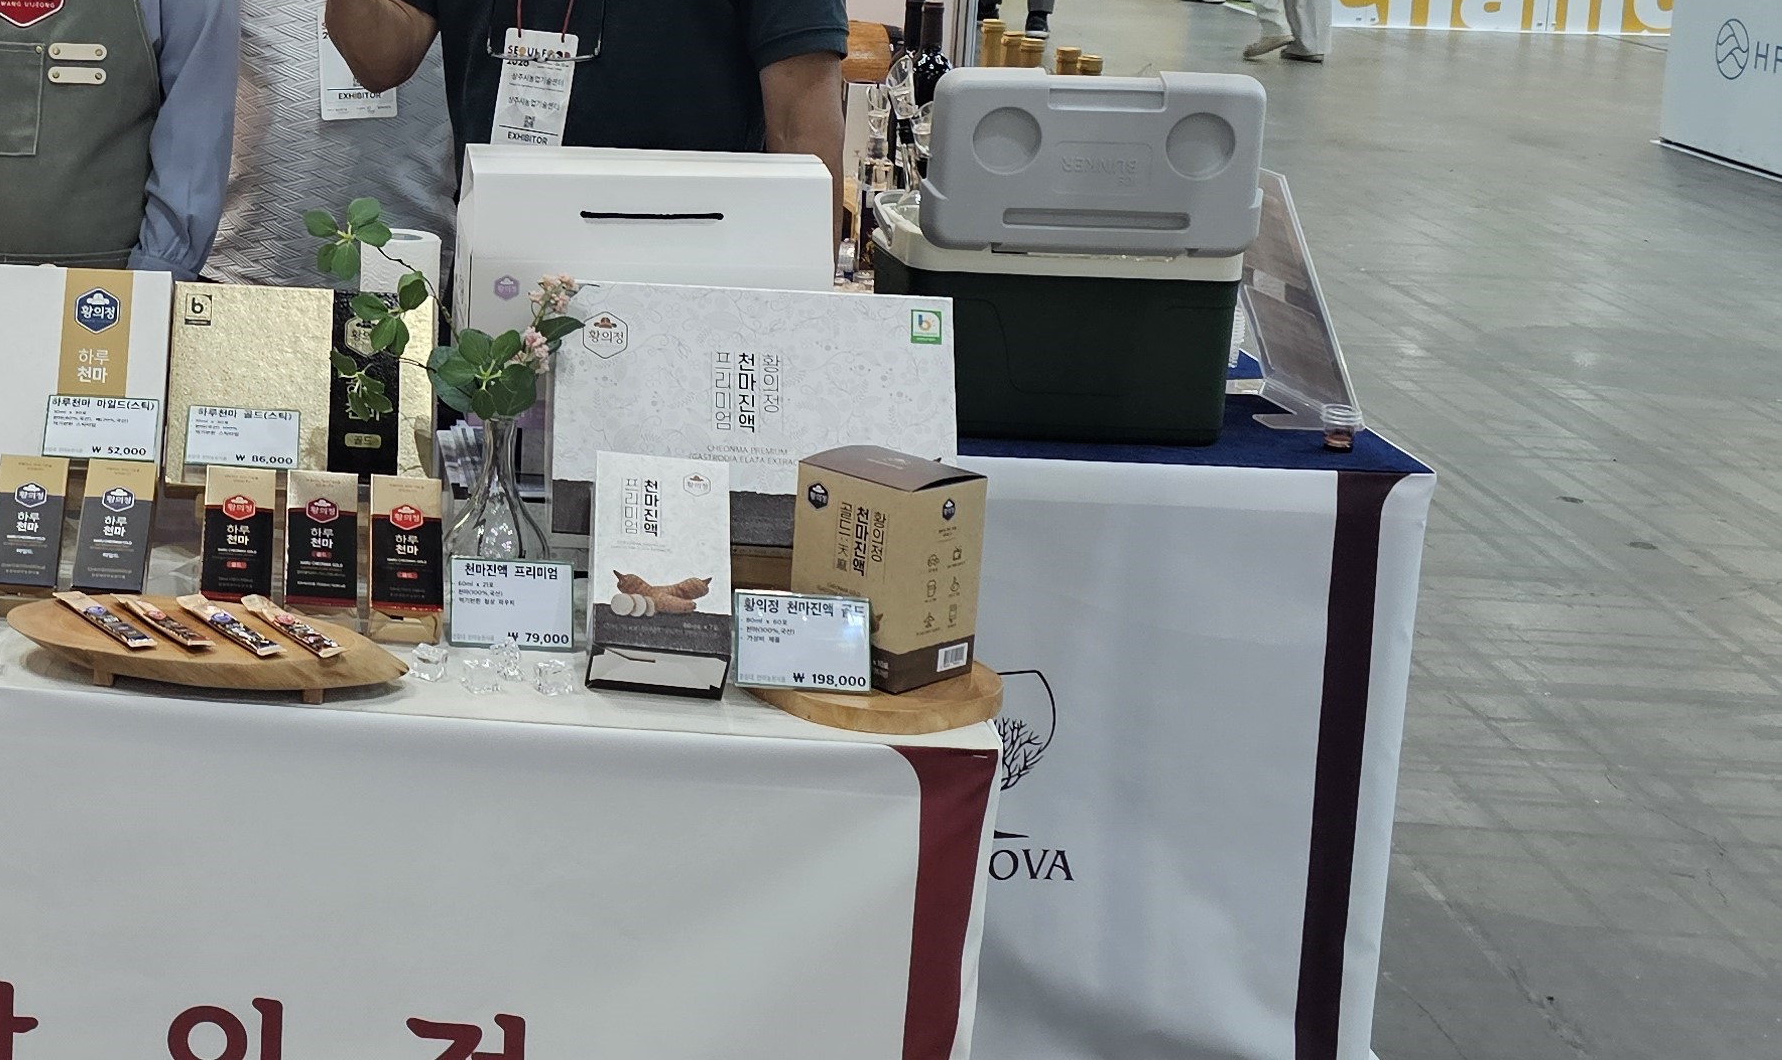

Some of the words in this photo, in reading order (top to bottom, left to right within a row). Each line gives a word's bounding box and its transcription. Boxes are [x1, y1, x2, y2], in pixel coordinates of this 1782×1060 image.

[511, 72, 565, 87] 상주시농업기술센터
[338, 91, 382, 100] EXHIBITOR
[508, 95, 561, 111] 상주시농업기술센터
[507, 131, 548, 145] EXHIBITOR
[81, 305, 115, 320] 황의정
[589, 331, 624, 344] 황의정
[78, 348, 110, 365] 하루
[77, 366, 108, 383] 천마
[763, 354, 780, 413] 황의정
[715, 352, 731, 430] 프리미엄
[738, 353, 756, 433] 천마진액
[52, 398, 91, 408] 하루천마
[97, 399, 155, 412] 마일드(스틱)
[198, 408, 237, 418] 하루천마
[243, 410, 292, 421] 골드(스틱)
[108, 446, 147, 456] 52,000
[707, 445, 748, 454] CHEONMA
[251, 454, 293, 465] 86,000
[19, 490, 44, 500] 황의정
[106, 494, 131, 504] 황의정
[227, 503, 252, 513] 황의정
[310, 506, 335, 516] 황의정
[625, 478, 638, 534] 프리미엄
[644, 480, 658, 536] 천마진액
[17, 511, 40, 522] 하루
[104, 515, 128, 526] 하루
[395, 512, 420, 523] 황의정
[16, 521, 39, 533] 천마
[103, 525, 126, 537] 천마
[227, 524, 250, 534] 하루
[310, 527, 334, 537] 하루
[226, 534, 249, 546] 천마
[310, 537, 333, 548] 천마
[395, 534, 419, 544] 하루
[853, 506, 869, 576] 천마진액
[871, 511, 886, 563] 황의정
[395, 543, 419, 556] 천마
[465, 563, 507, 577] 천마진액
[515, 566, 557, 580] 프리미엄
[744, 598, 778, 613] 황의정
[787, 600, 833, 617] 천마진액
[525, 633, 569, 645] 79,000
[812, 673, 866, 687] 198,000
